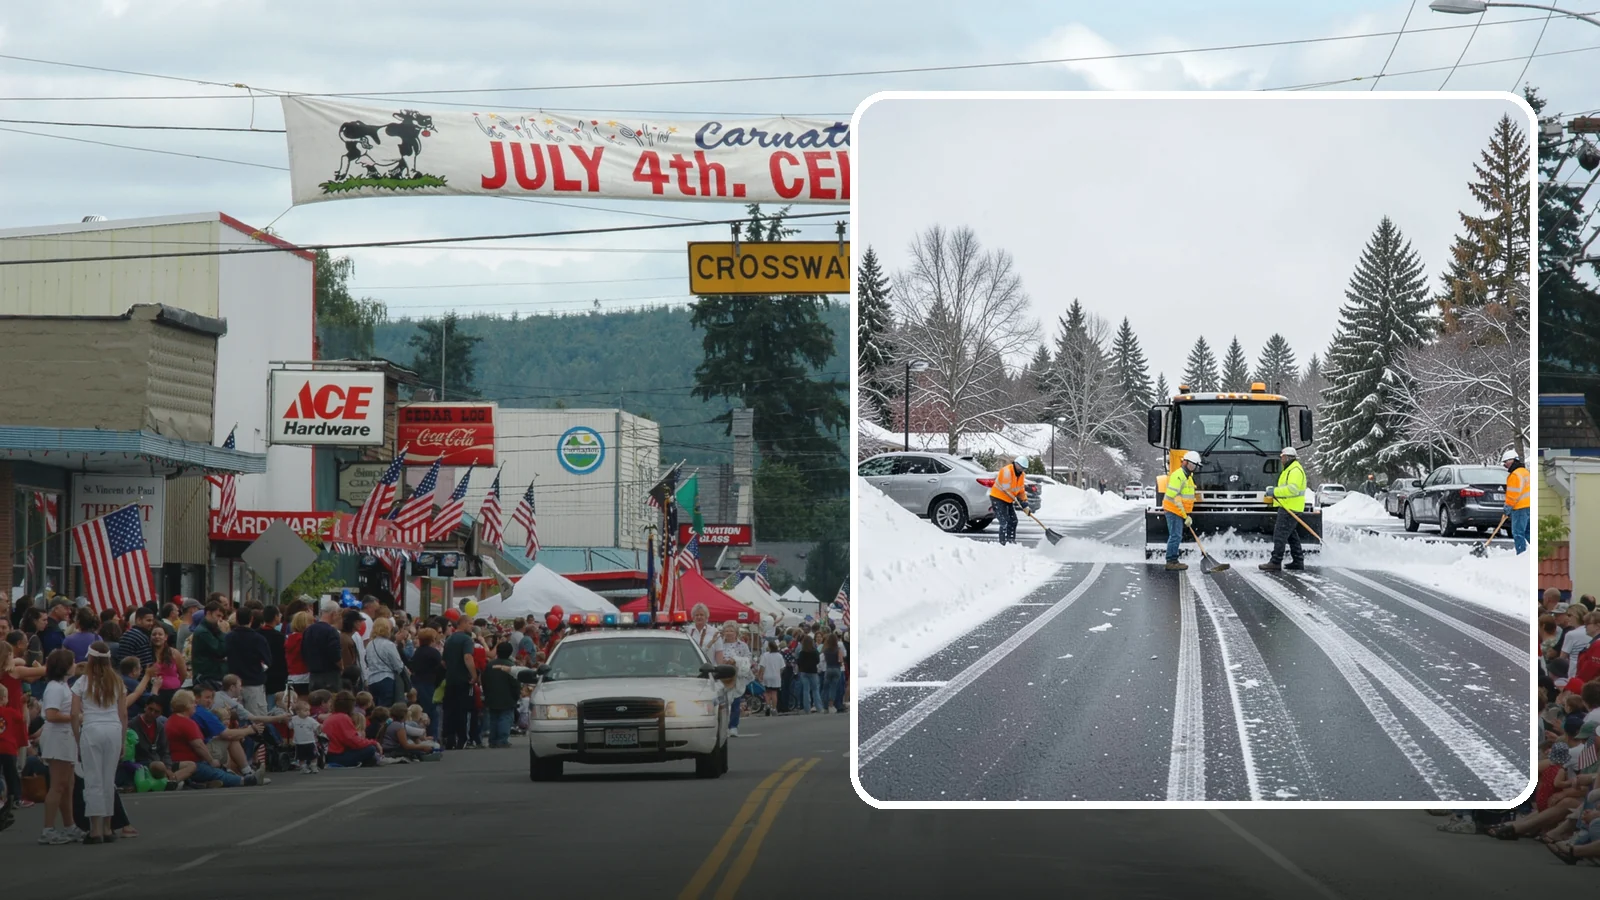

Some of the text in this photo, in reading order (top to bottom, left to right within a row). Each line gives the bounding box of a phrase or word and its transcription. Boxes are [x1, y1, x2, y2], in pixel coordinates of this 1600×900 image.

[481, 141, 605, 192] JULY
[632, 150, 746, 198] 4th.
[697, 254, 850, 280] CROSSWA
[282, 380, 373, 420] ACE
[405, 409, 485, 422] CEDAR LOG
[283, 421, 371, 436] Hardware
[354, 467, 386, 480] Simpl
[83, 484, 155, 495] St. Vincent de Paul
[688, 526, 741, 535] CRNATION
[699, 535, 730, 543] GLASS
